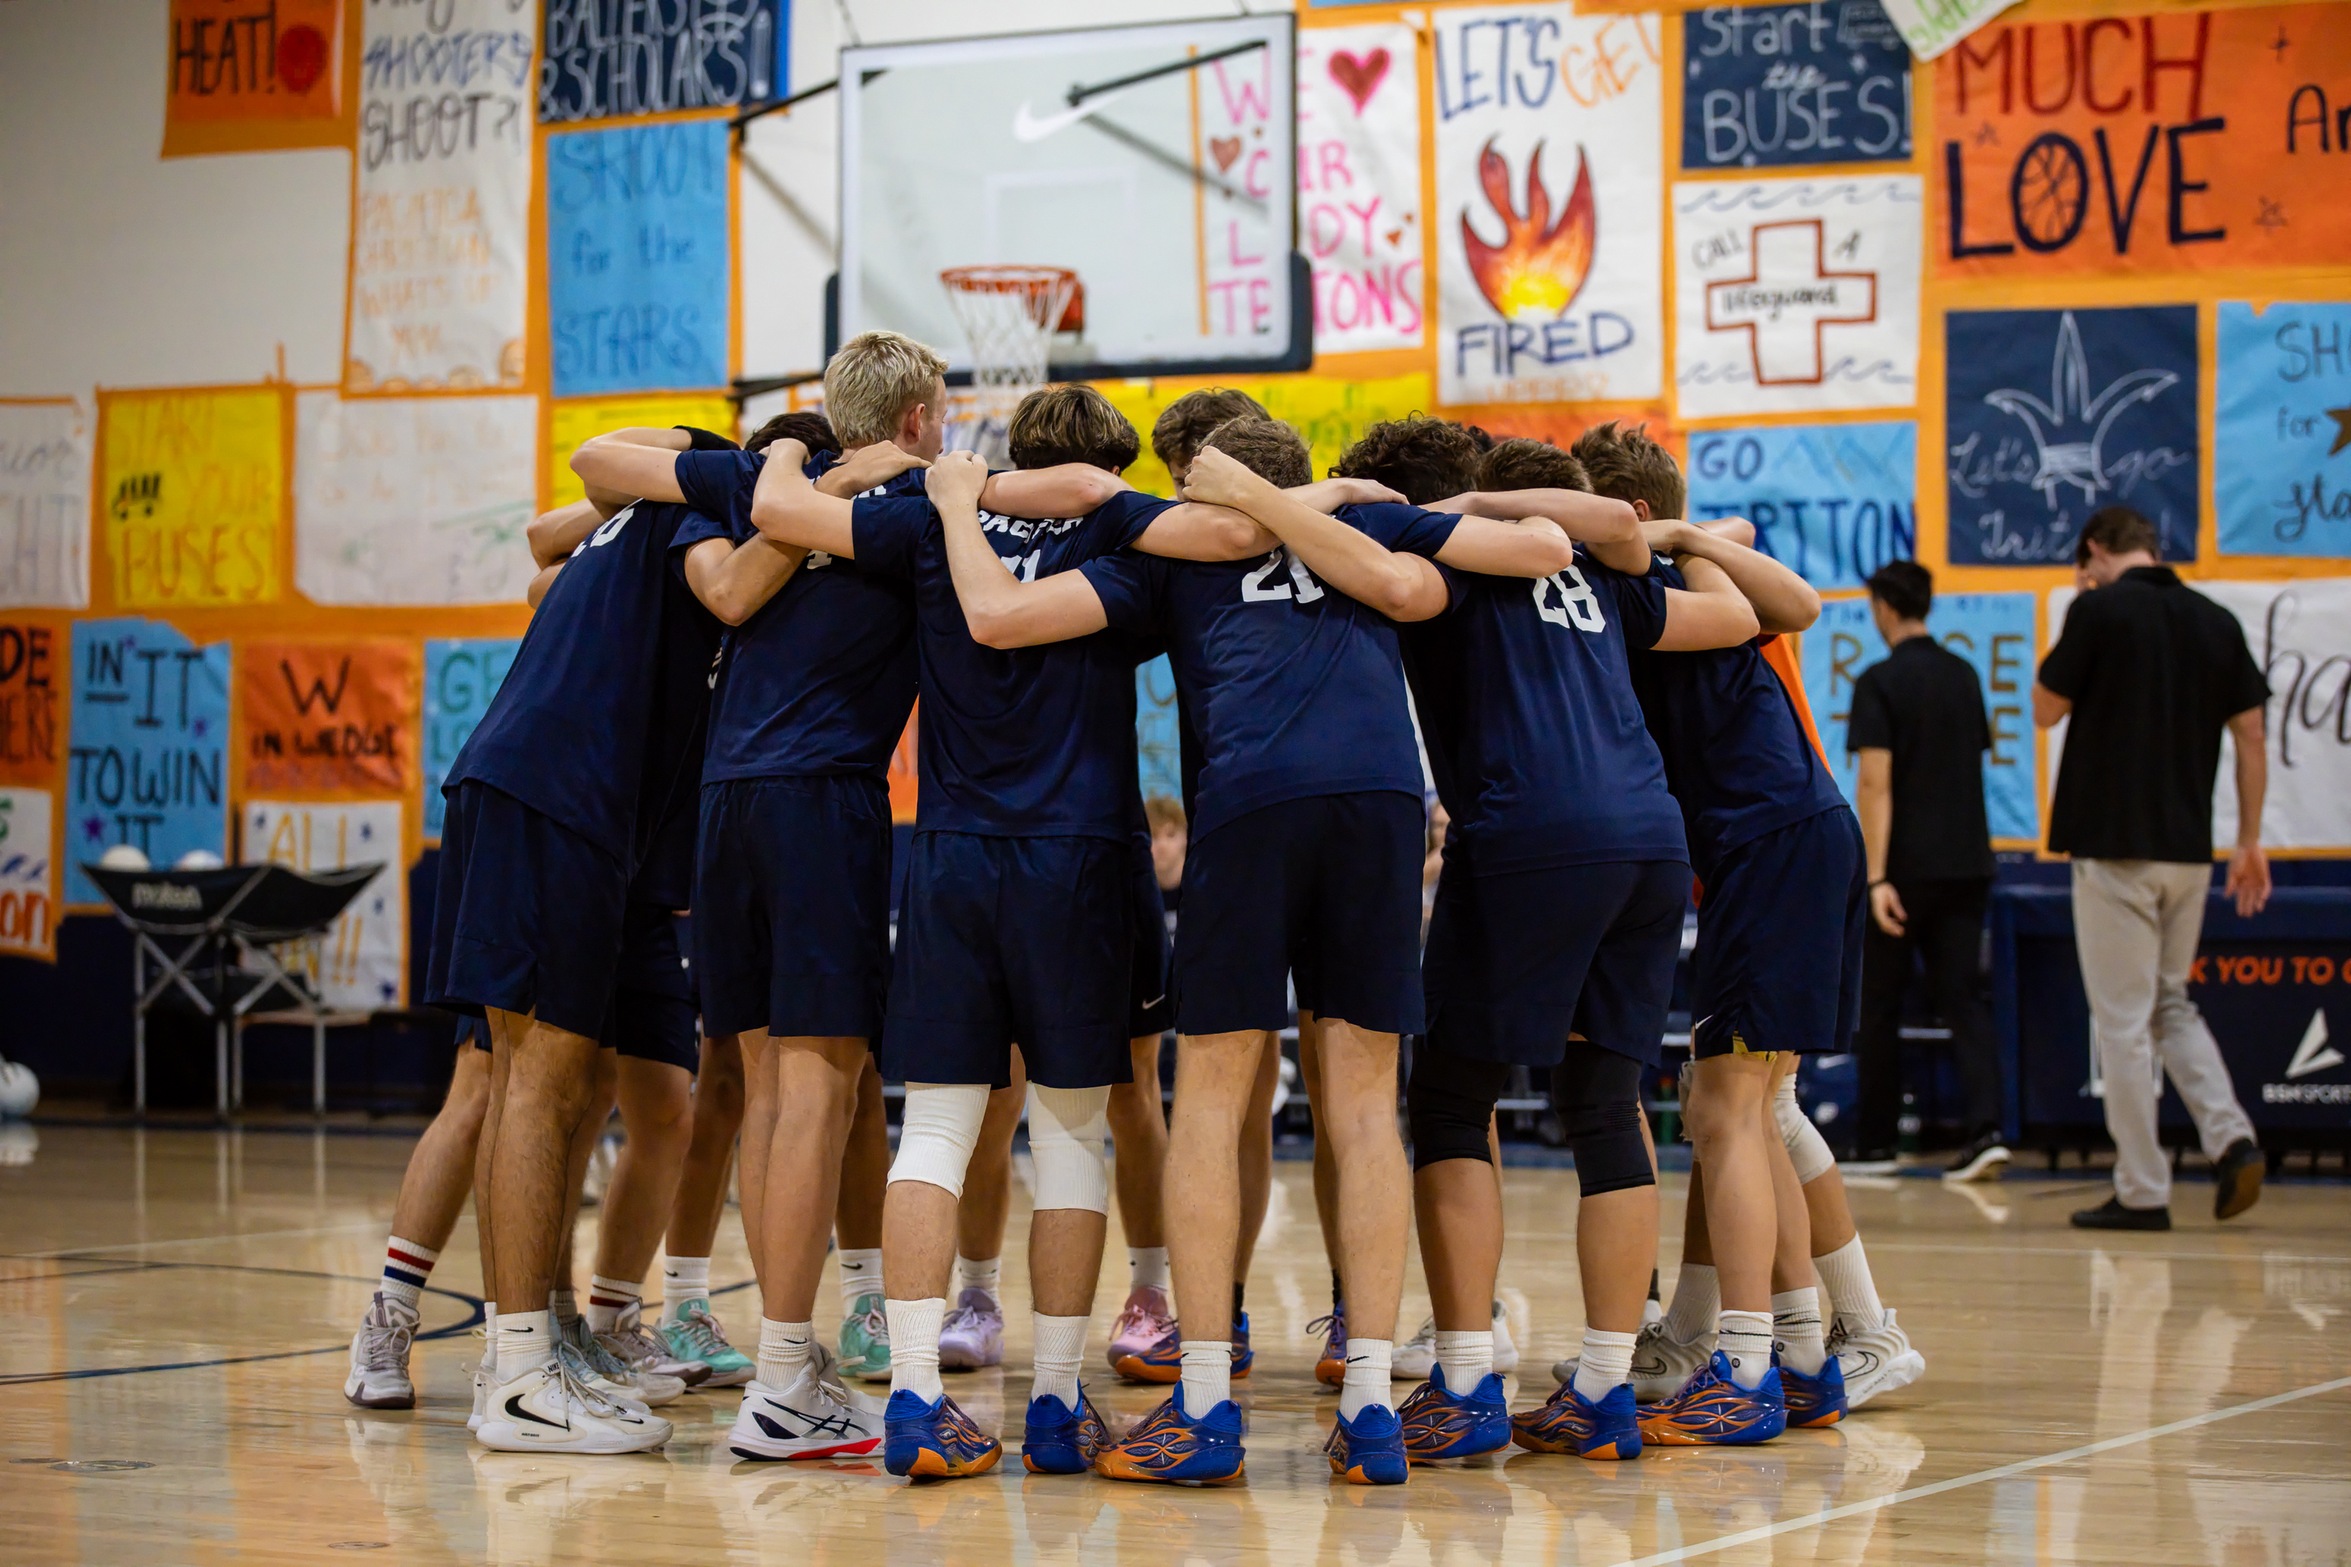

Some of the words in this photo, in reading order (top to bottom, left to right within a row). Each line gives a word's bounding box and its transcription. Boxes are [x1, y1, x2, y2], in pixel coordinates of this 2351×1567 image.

[1700, 1, 1833, 56] Start
[1950, 11, 2212, 121] MUCH
[1702, 72, 1913, 164] BUSES!
[1945, 115, 2226, 260] LOVE
[1457, 311, 1635, 378] FIRED
[2274, 319, 2351, 384] SH
[1696, 433, 1766, 483] GO
[87, 641, 128, 686] IN
[279, 656, 350, 716] W
[2215, 955, 2284, 986] YOU
[2290, 955, 2335, 987] TO
